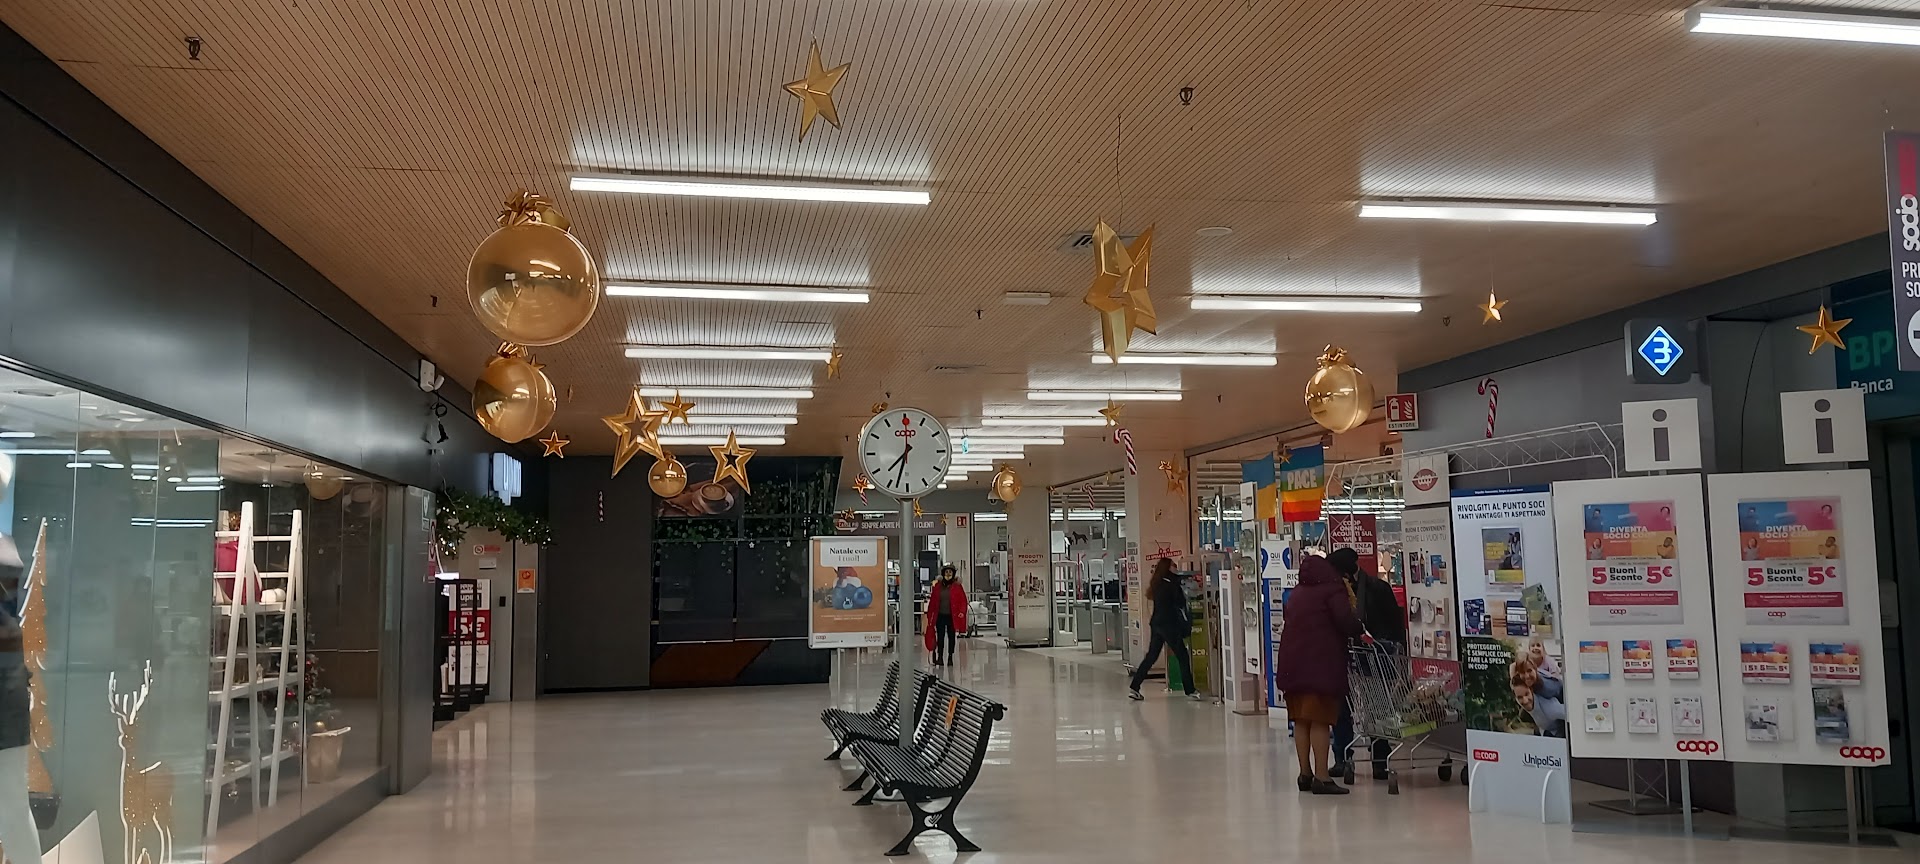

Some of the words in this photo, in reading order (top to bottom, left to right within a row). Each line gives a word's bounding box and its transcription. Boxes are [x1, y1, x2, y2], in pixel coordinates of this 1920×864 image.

[1896, 194, 1920, 251] socio
[1848, 331, 1893, 370] BP
[1287, 468, 1318, 490] PACE
[1457, 503, 1490, 512] RIVOLGITI
[1503, 501, 1526, 510] PUNTO
[1529, 500, 1545, 509] SOCI
[1511, 510, 1546, 518] ASPETTANO
[1592, 567, 1607, 585] 5
[1647, 566, 1673, 584] 5€
[1747, 567, 1764, 586] 5
[1807, 566, 1836, 585] 5€
[1489, 657, 1506, 665] SPESA
[1480, 751, 1497, 760] COOP
[1676, 740, 1718, 755] coop
[1839, 746, 1885, 762] coop
